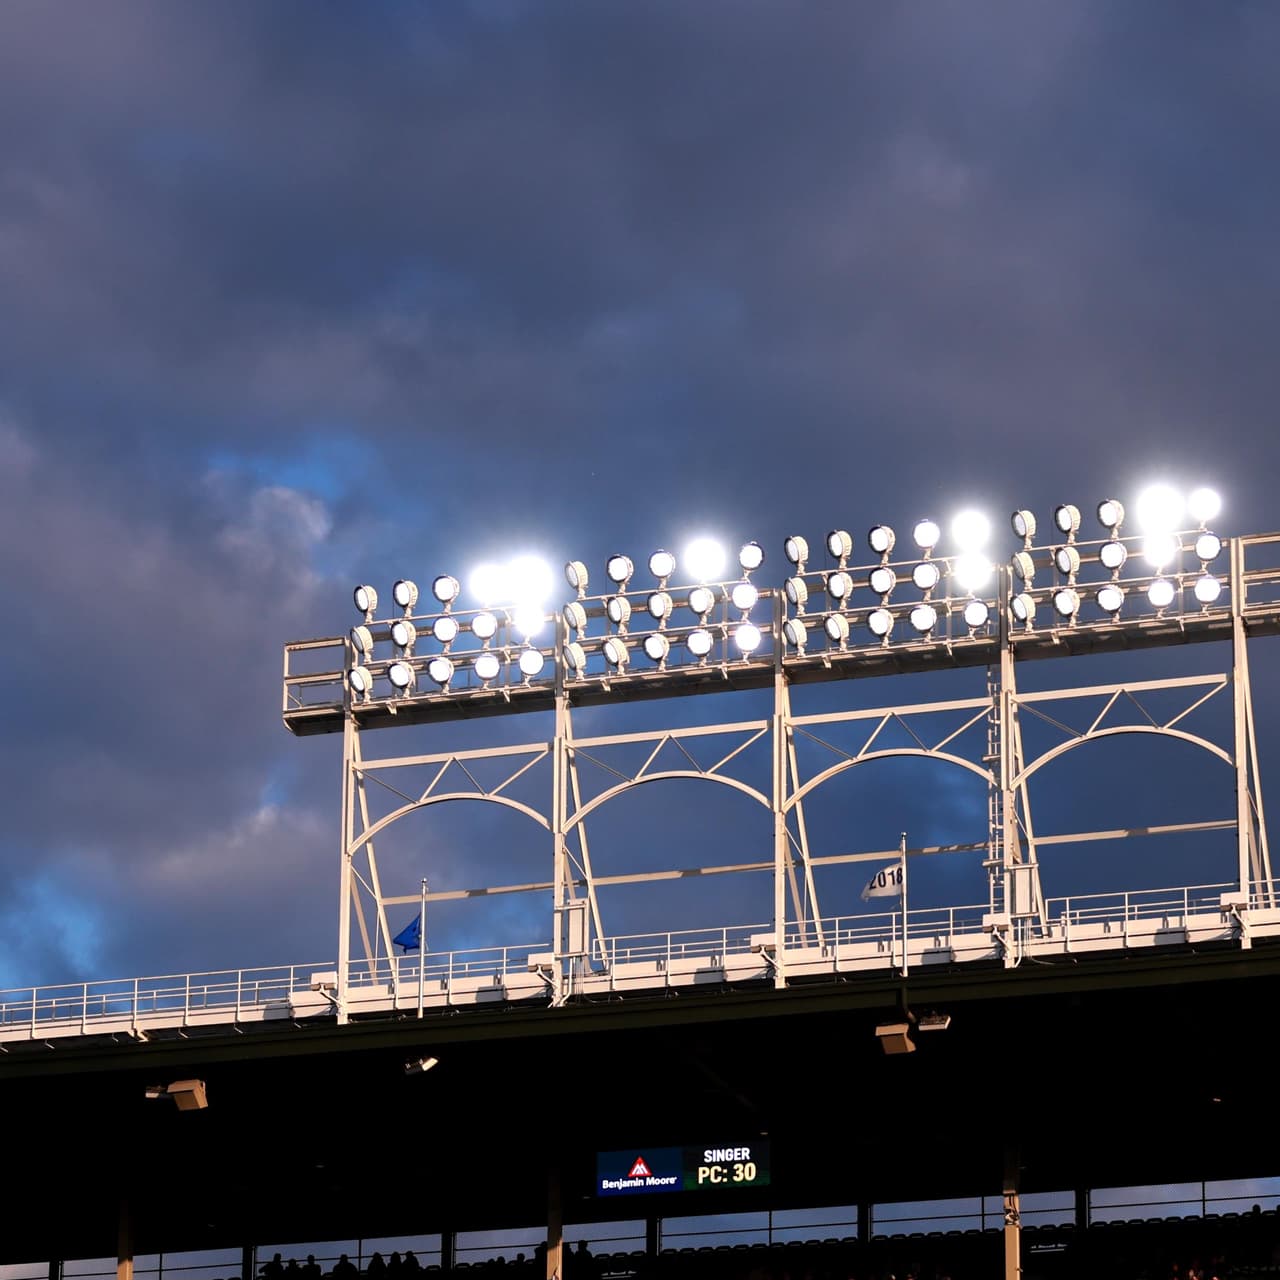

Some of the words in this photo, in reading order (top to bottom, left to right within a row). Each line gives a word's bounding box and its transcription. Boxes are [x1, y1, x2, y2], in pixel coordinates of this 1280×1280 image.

[869, 867, 903, 890] 2018
[704, 1147, 751, 1163] SINGER
[698, 1164, 728, 1184] PC:
[732, 1162, 757, 1182] 30
[602, 1177, 644, 1190] Benjamin
[646, 1176, 677, 1187] Moore
